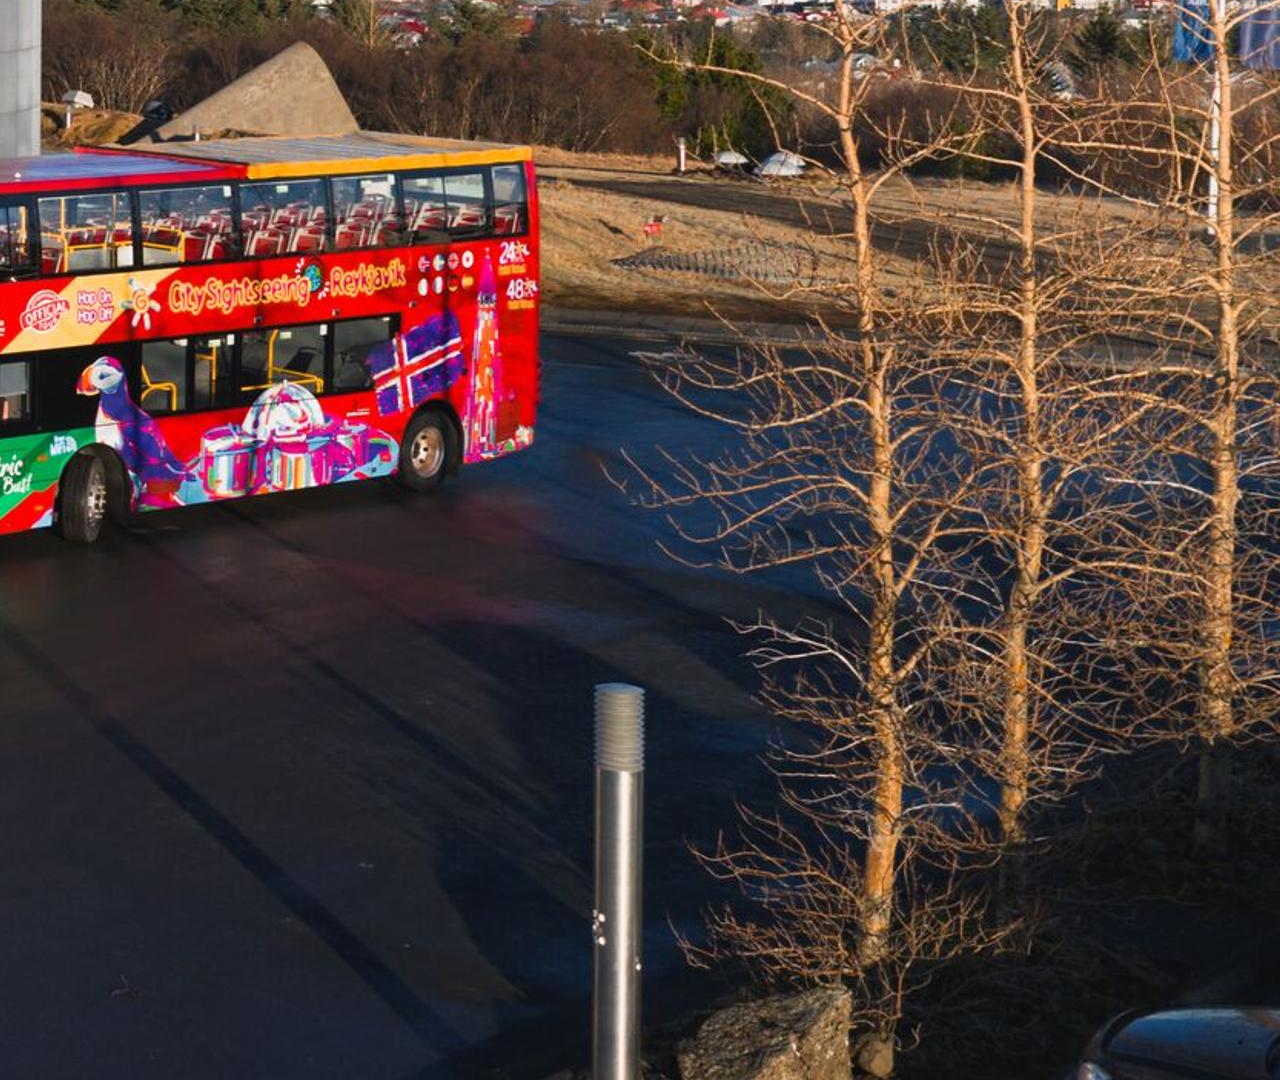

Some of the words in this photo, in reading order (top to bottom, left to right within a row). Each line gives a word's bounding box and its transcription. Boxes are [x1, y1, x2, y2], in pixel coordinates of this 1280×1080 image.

[329, 258, 407, 297] Reykjavik
[77, 290, 97, 306] Hop
[98, 288, 113, 304] On
[506, 278, 524, 300] 48
[25, 301, 66, 326] OFFICIAL
[77, 308, 98, 324] Hop
[98, 306, 115, 322] Off
